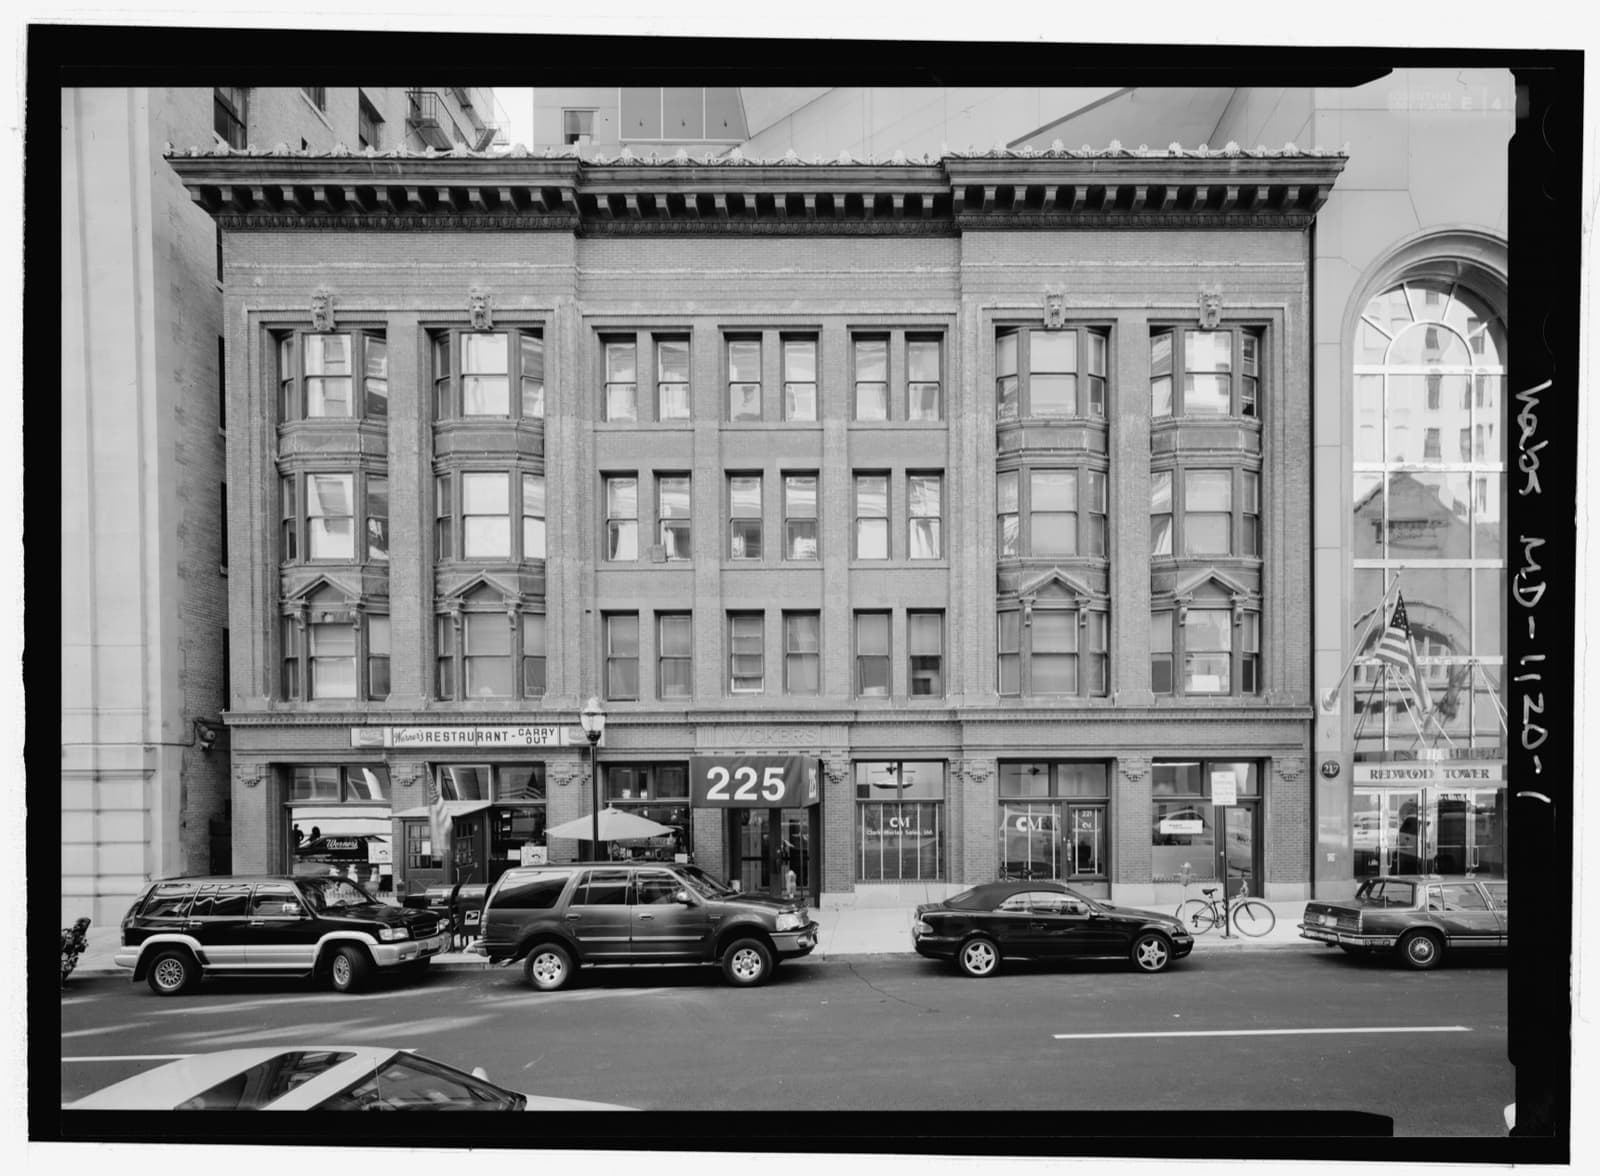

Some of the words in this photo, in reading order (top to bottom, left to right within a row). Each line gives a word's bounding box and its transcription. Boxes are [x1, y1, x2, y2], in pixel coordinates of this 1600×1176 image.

[426, 731, 508, 742] RESTAURANT
[518, 728, 555, 737] CARRY
[526, 736, 548, 745] OUT
[727, 727, 817, 744] VICKERS
[1323, 763, 1340, 776] 217
[1370, 768, 1434, 780] REDWOOD
[1443, 768, 1490, 780] TOWER
[706, 766, 785, 802] 225
[889, 816, 910, 828] CM
[1015, 815, 1043, 833] CM
